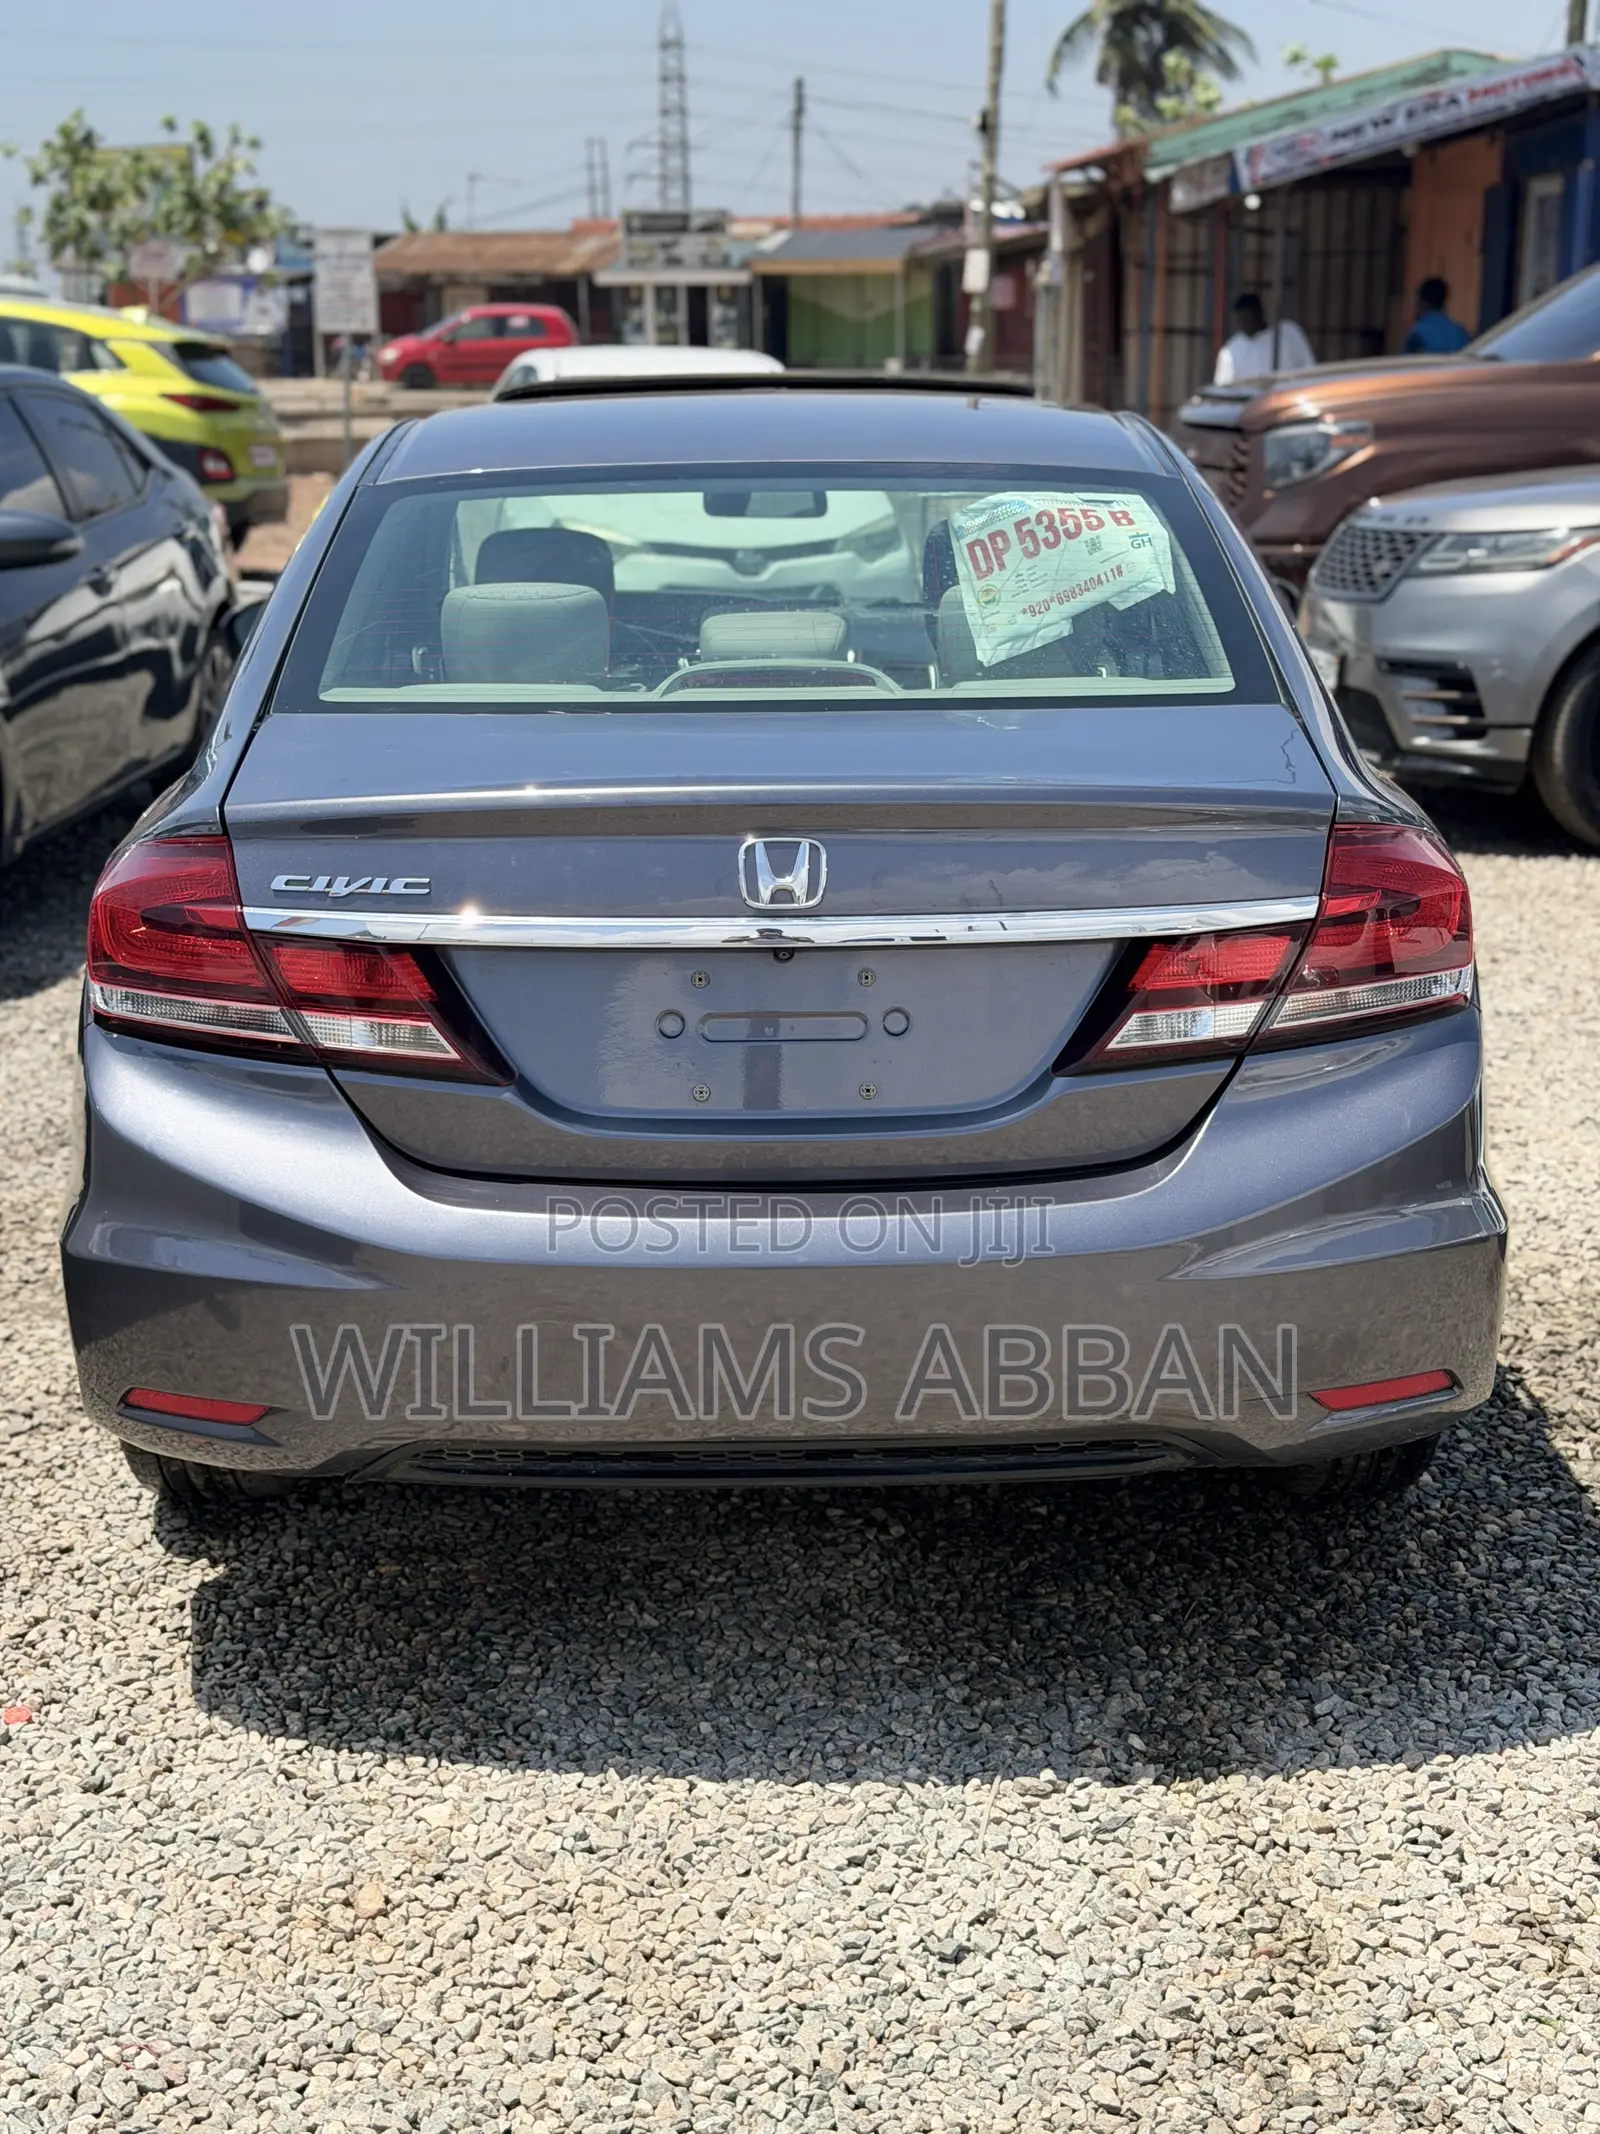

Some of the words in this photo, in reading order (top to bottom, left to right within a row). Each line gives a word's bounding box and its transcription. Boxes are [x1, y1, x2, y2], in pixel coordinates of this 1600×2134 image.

[966, 529, 1012, 581] DP
[1013, 507, 1105, 560] 5355
[1130, 537, 1153, 549] GH
[271, 875, 430, 897] CIVIC
